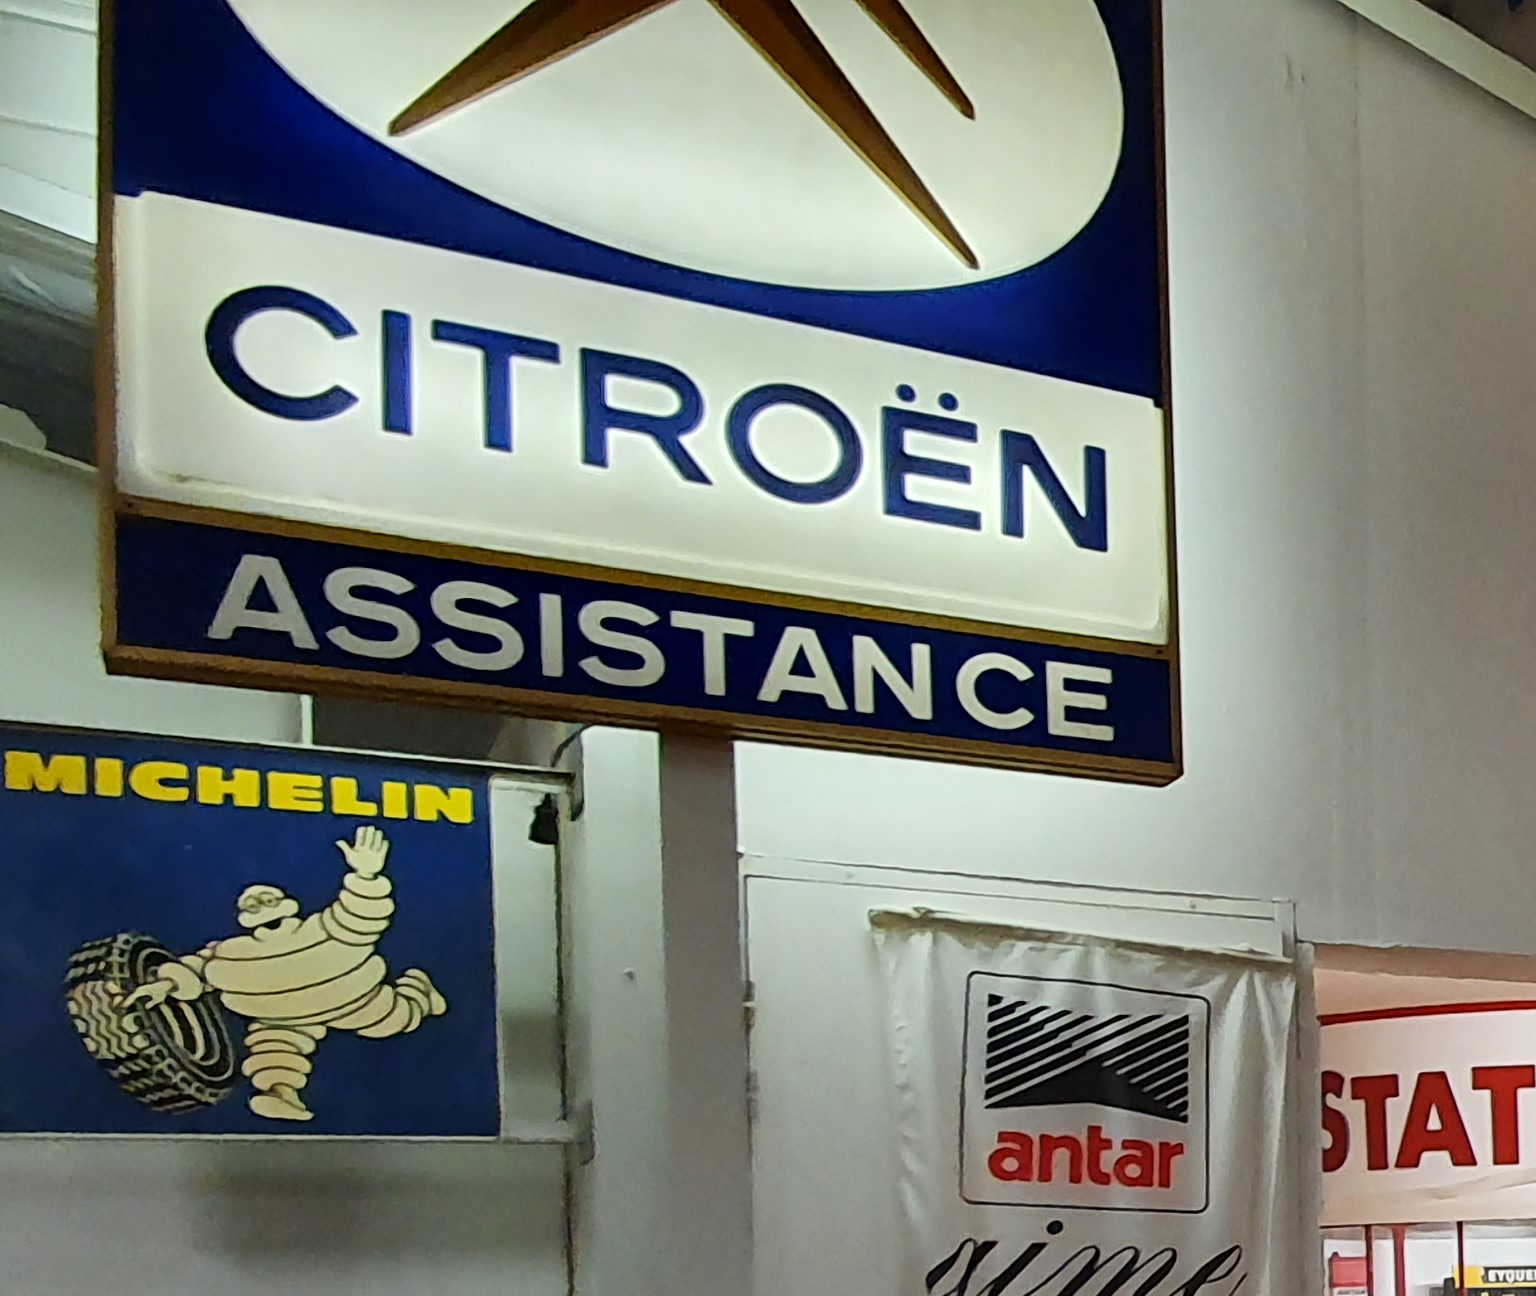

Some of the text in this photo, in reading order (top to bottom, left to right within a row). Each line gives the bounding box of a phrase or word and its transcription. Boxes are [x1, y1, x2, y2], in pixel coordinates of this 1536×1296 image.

[204, 284, 1109, 553] CITROËN
[206, 554, 1116, 742] ASSISTANCE
[4, 750, 473, 824] MICHELIN
[986, 1125, 1185, 1188] antar
